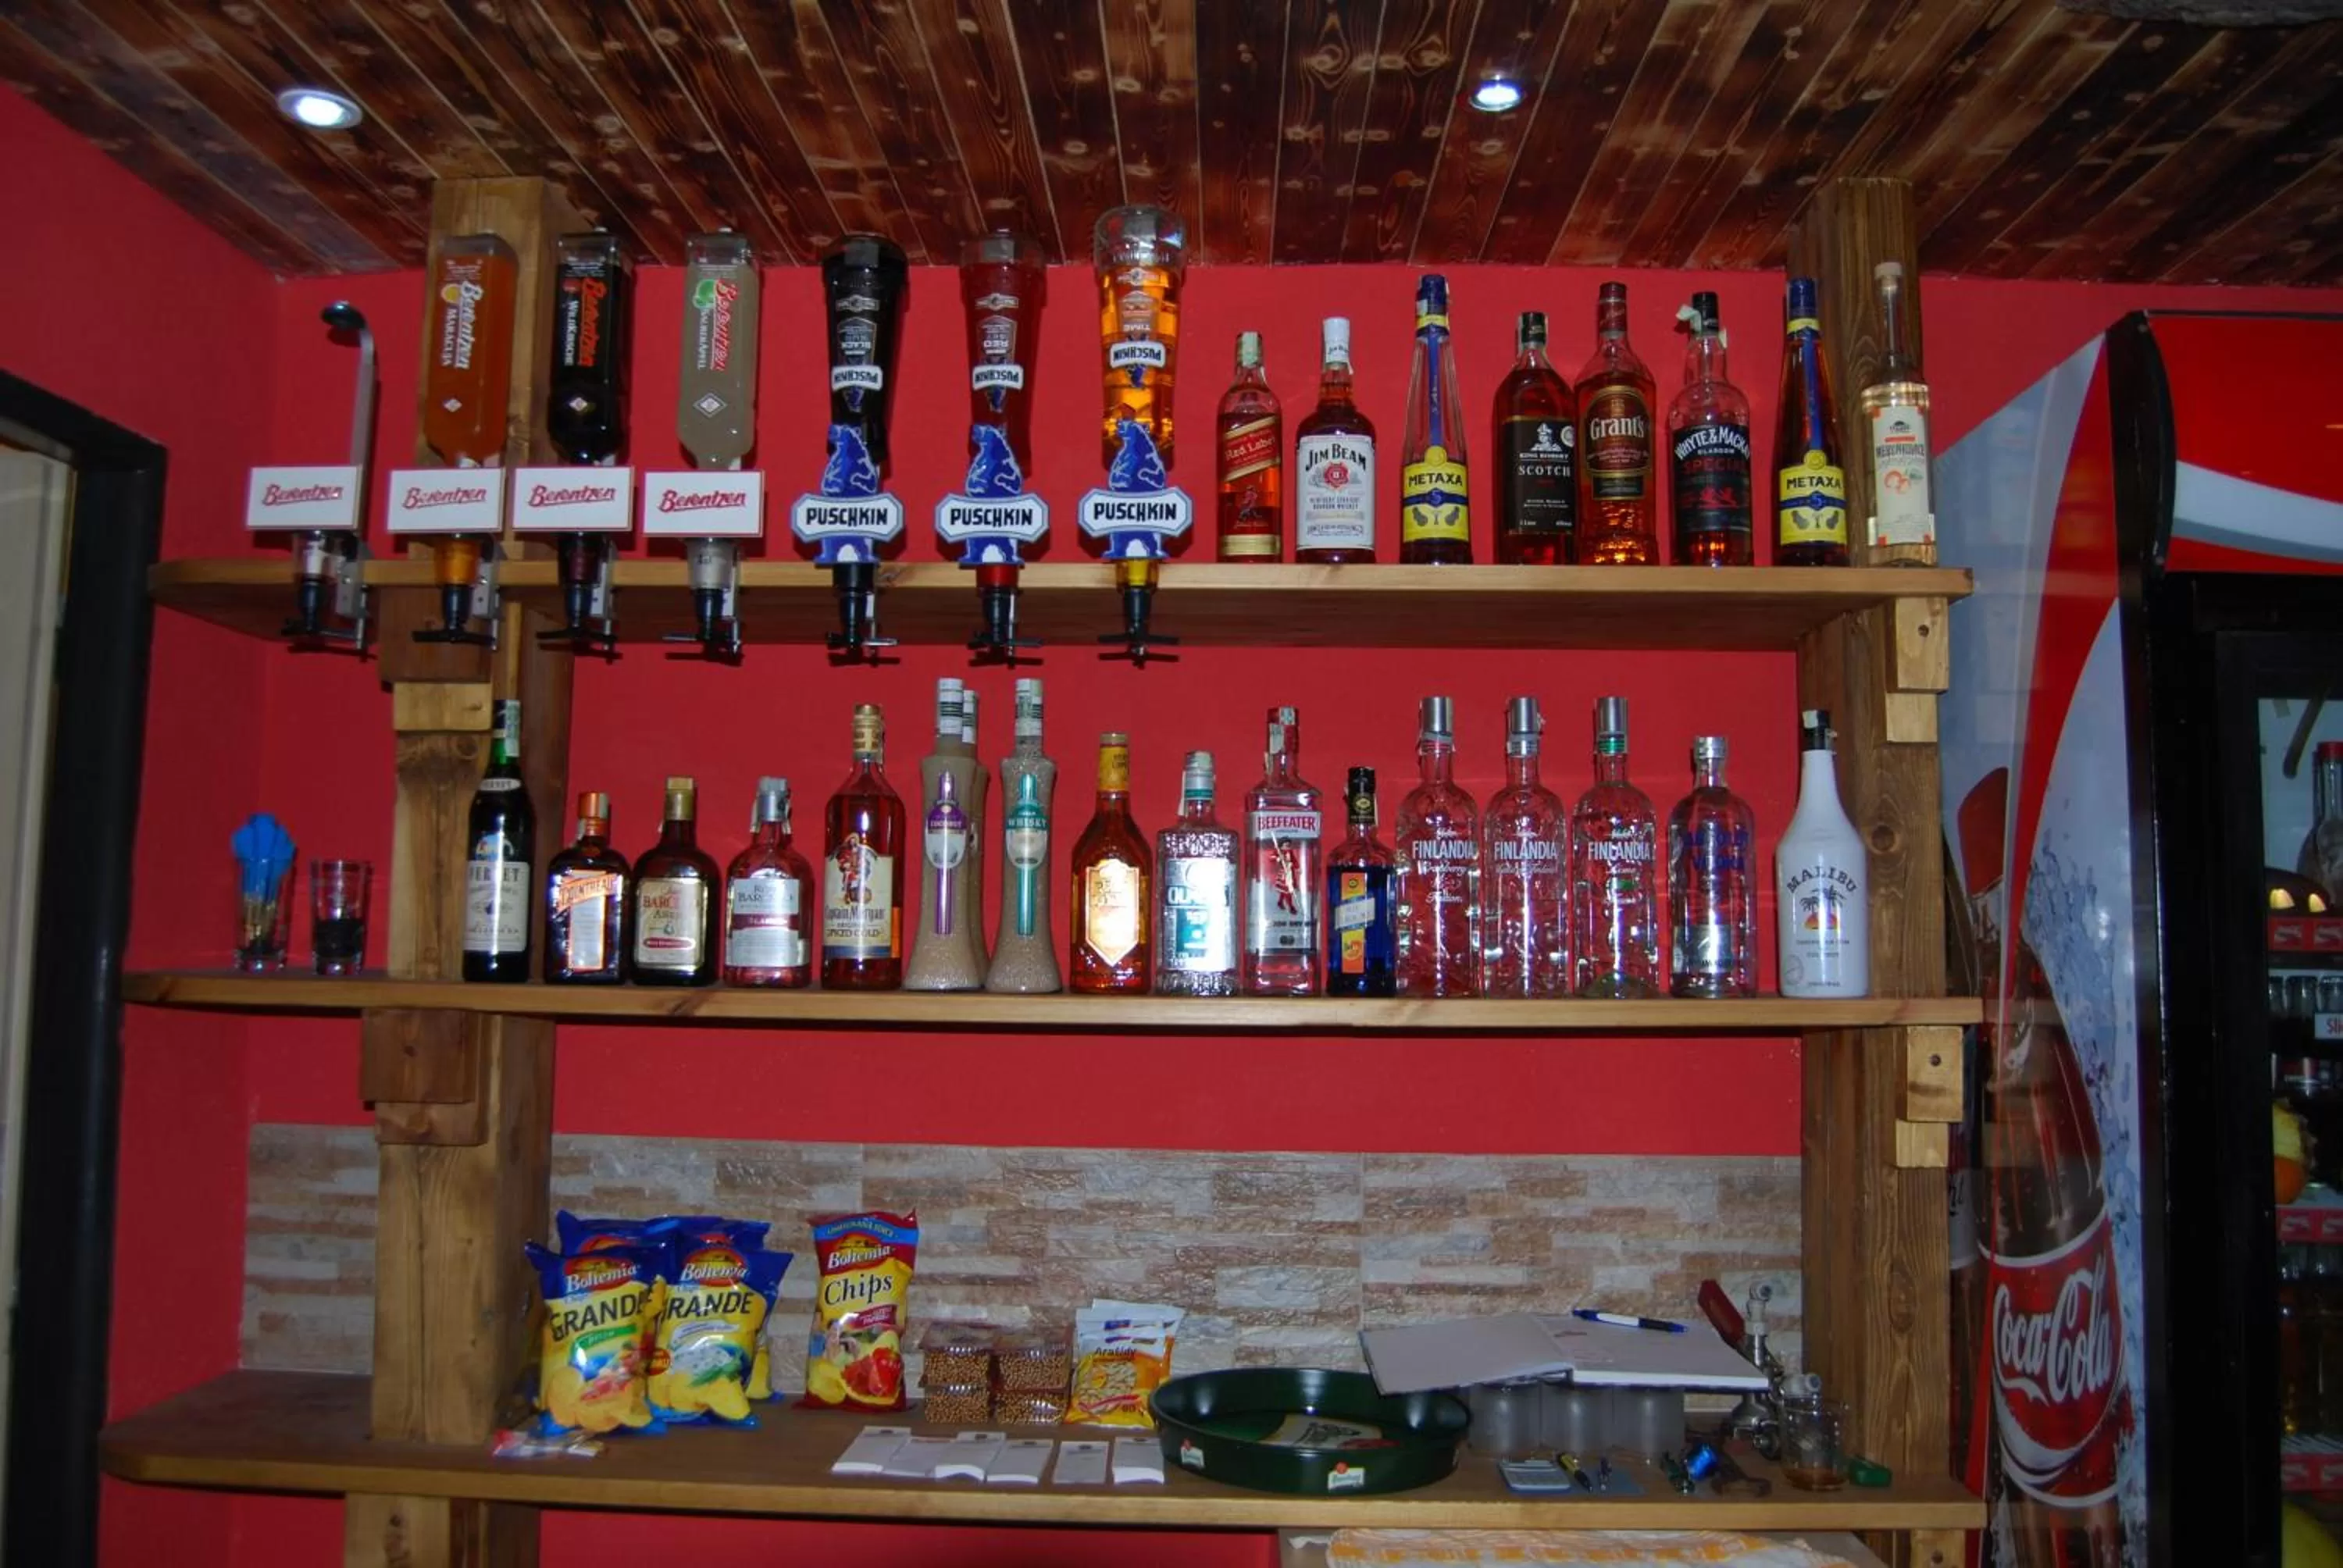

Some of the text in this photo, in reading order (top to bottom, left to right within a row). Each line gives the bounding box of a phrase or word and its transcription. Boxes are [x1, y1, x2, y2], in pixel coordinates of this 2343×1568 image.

[455, 280, 483, 369] Berentzen
[579, 278, 607, 367] Berentzen
[710, 279, 738, 371] Berentzen
[1114, 347, 1162, 362] PUSCHKIN
[834, 368, 879, 383] PUSCHKIN
[975, 369, 1019, 383] PUSCHKIN
[1305, 443, 1366, 472] JIM BEAM
[1408, 472, 1464, 487] METAXA
[1517, 465, 1571, 477] SCOTCH
[1786, 476, 1842, 490] METAXA
[262, 484, 344, 506] Berentzen
[402, 487, 487, 509] Berentzen
[528, 485, 616, 508] Berentzen
[658, 490, 746, 512] Berentzen
[806, 508, 888, 528] PUSCHKIN
[950, 508, 1033, 528] PUSCHKIN
[1094, 501, 1177, 522] PUSCHKIN
[1257, 816, 1316, 832] BEEFEATER
[1412, 839, 1476, 859] FINLANDIA
[1494, 840, 1557, 860] FINLANDIA
[1588, 841, 1650, 861] FINLANDIA
[1787, 865, 1857, 894] MALIBU
[828, 1245, 891, 1269] Bohemia
[565, 1261, 638, 1294] Bohemia
[680, 1262, 748, 1281] Bohemia
[825, 1273, 893, 1306] Chips
[1993, 1251, 2112, 1406] Coca-Cola
